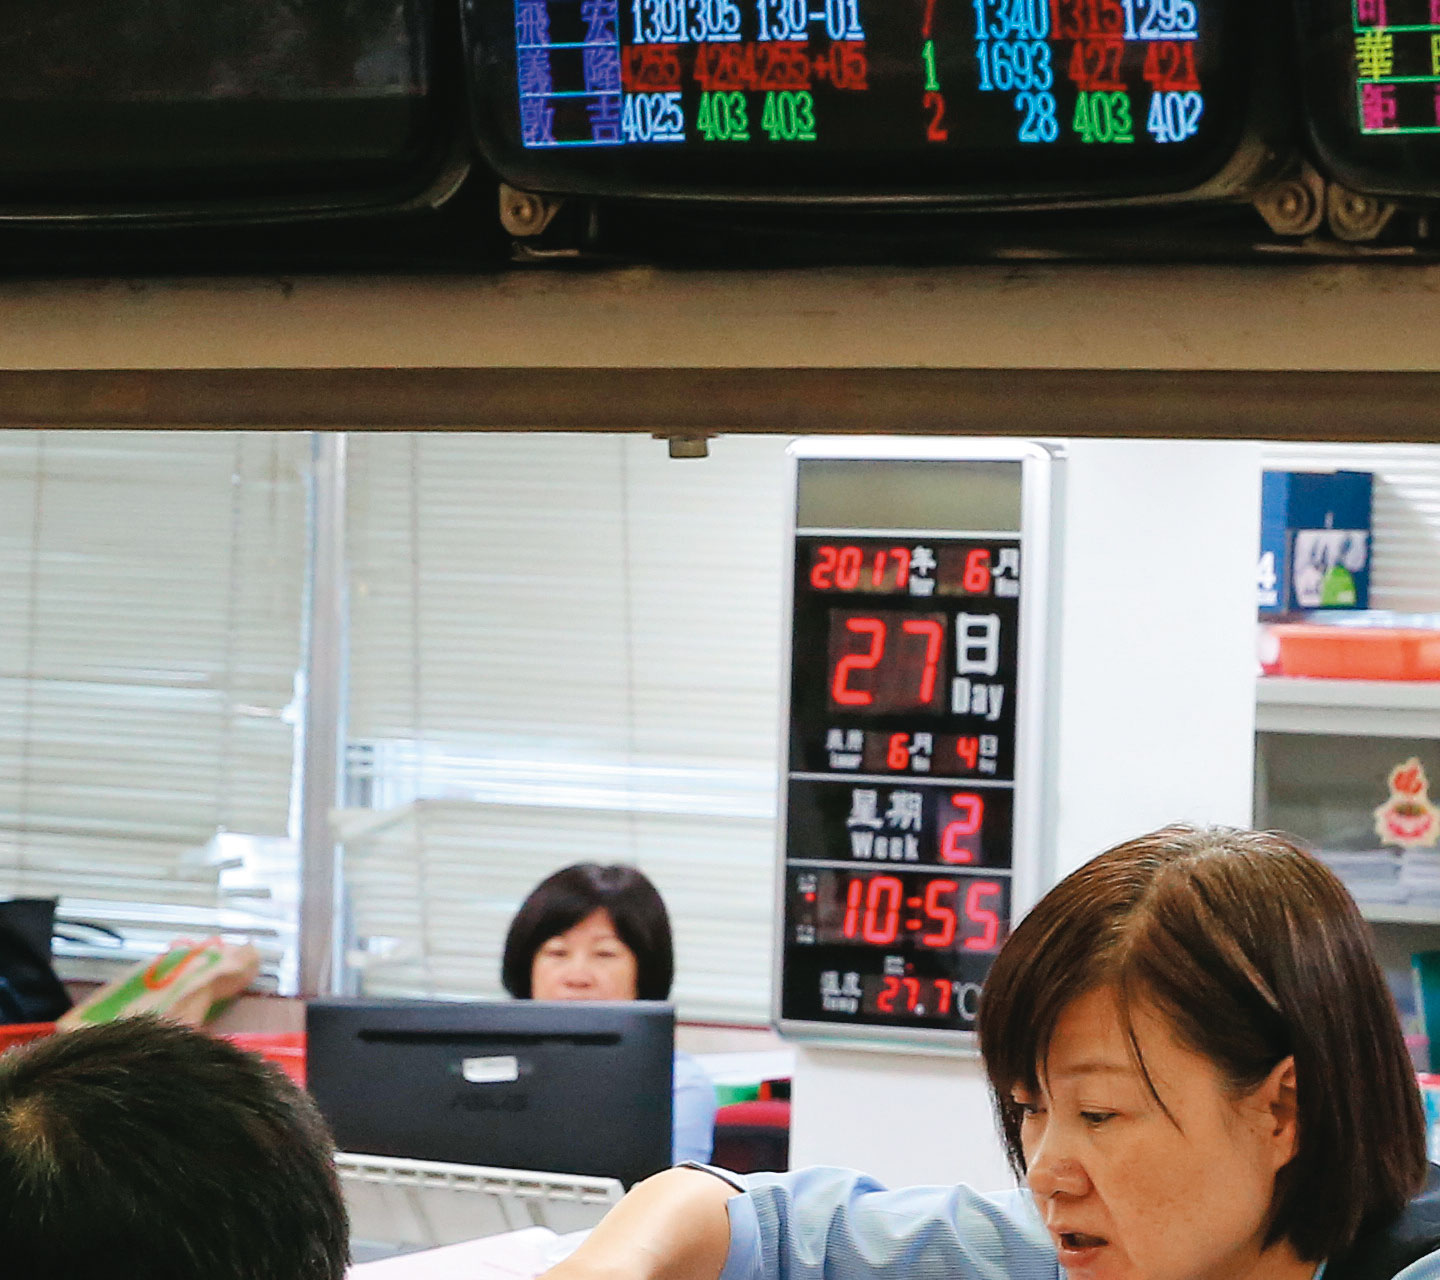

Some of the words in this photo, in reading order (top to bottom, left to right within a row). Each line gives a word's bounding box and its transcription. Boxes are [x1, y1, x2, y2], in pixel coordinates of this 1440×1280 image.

[979, 42, 1052, 90] 1693
[1015, 94, 1058, 142] 28
[1072, 92, 1132, 142] 403
[1148, 91, 1202, 142] 402
[811, 546, 910, 589] 2017
[963, 549, 990, 592] 6
[832, 618, 943, 705] 27
[956, 612, 1000, 676] 日
[887, 732, 909, 769] 6
[957, 737, 978, 769] 4
[940, 793, 984, 863] 2
[844, 876, 1000, 951] 10:55
